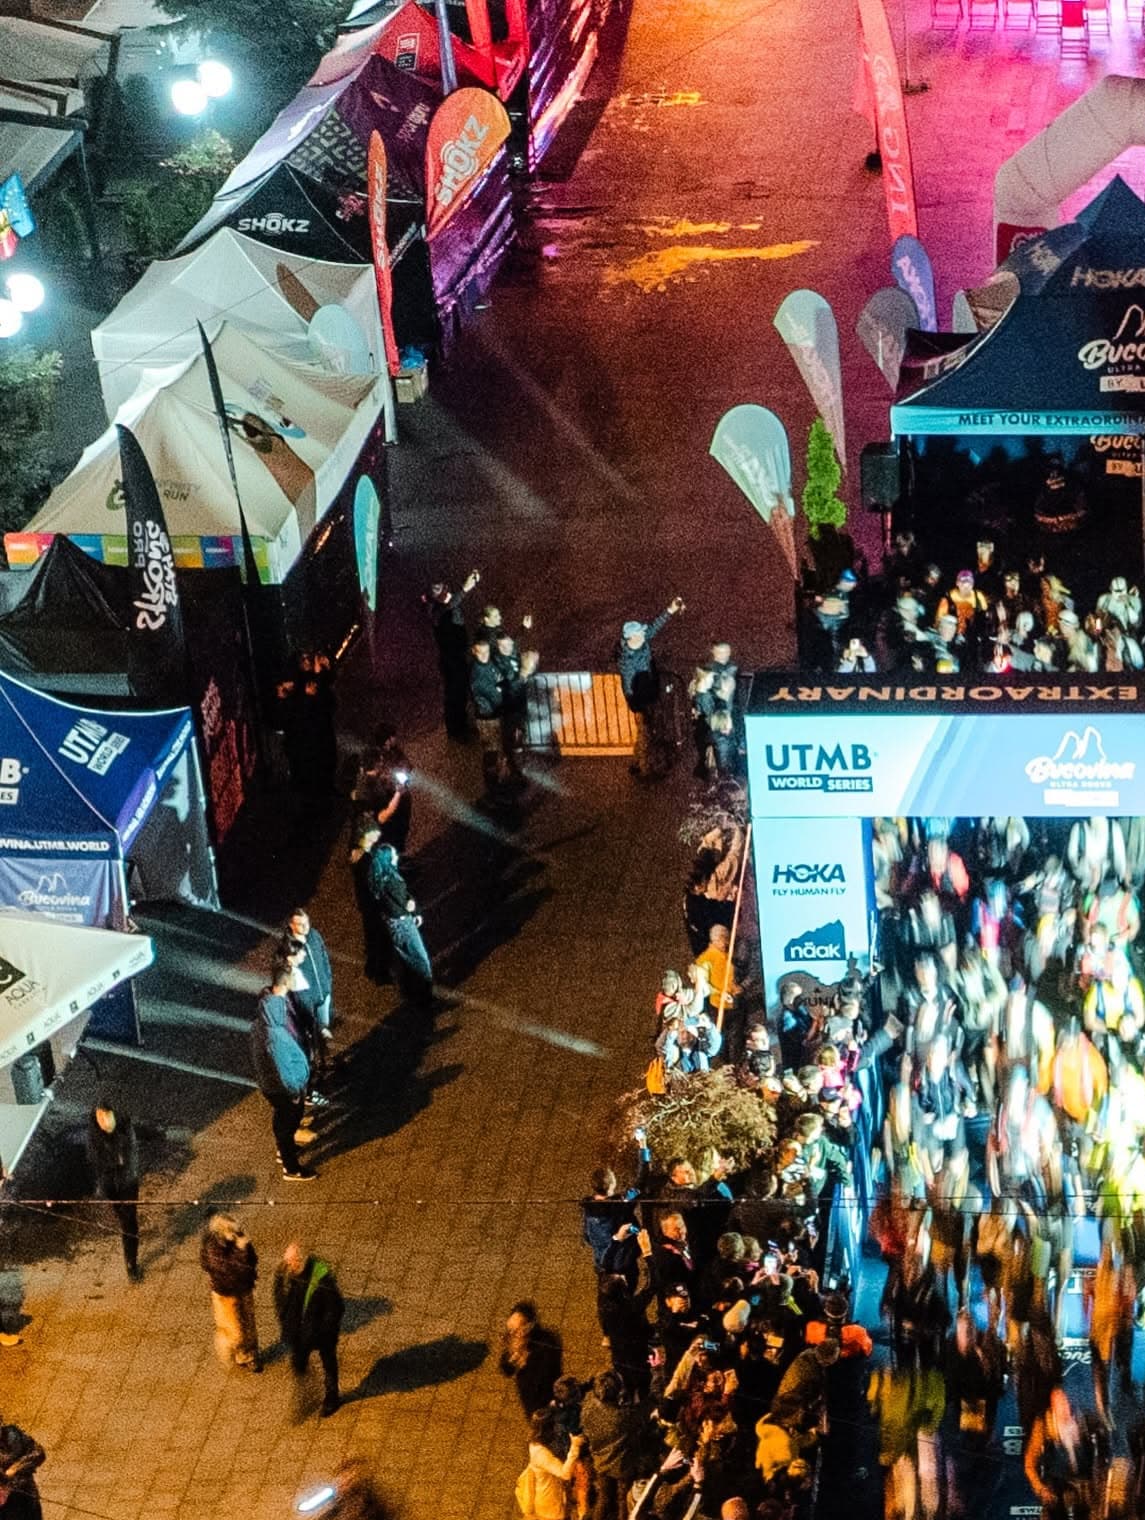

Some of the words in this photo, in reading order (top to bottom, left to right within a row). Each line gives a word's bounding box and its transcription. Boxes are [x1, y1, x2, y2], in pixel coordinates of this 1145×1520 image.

[435, 115, 488, 205] SHOKZ
[237, 213, 310, 235] SHOKZ
[959, 413, 994, 425] MEET
[1000, 413, 1041, 425] YOUR
[163, 489, 189, 501] RUN
[768, 686, 1138, 701] EXTRAORDINARY
[765, 743, 873, 771] UTMB
[771, 776, 823, 790] WORLD
[827, 778, 872, 792] SERIES
[773, 864, 846, 884] HOKA
[773, 888, 788, 897] FLY
[790, 888, 828, 896] HUMAN
[831, 887, 846, 896] FLY
[790, 942, 841, 959] näak
[5, 978, 41, 1006] AQUA
